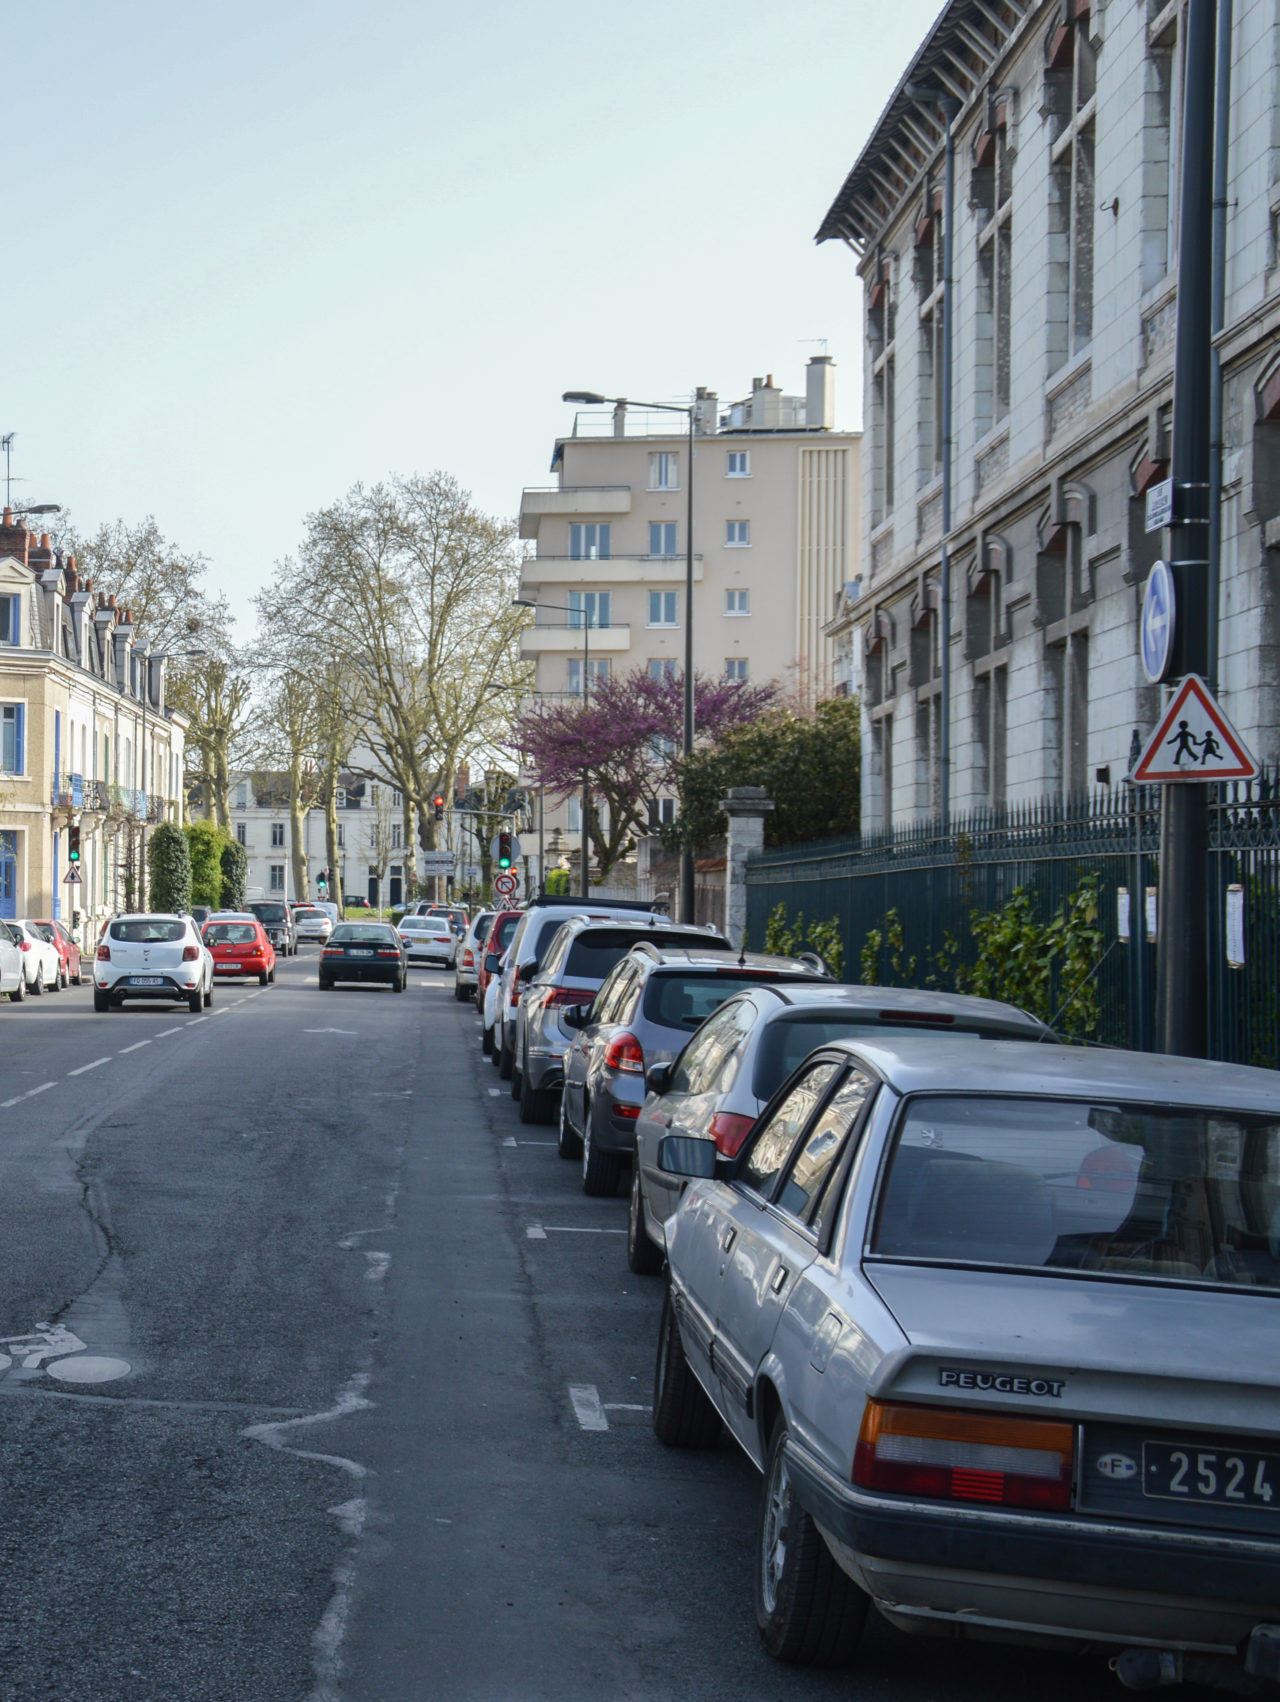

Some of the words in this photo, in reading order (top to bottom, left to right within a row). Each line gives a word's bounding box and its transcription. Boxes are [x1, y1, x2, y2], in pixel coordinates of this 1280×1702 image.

[940, 1370, 1064, 1397] PEUGEOT
[1110, 1458, 1122, 1474] F
[1169, 1451, 1273, 1502] 2524
